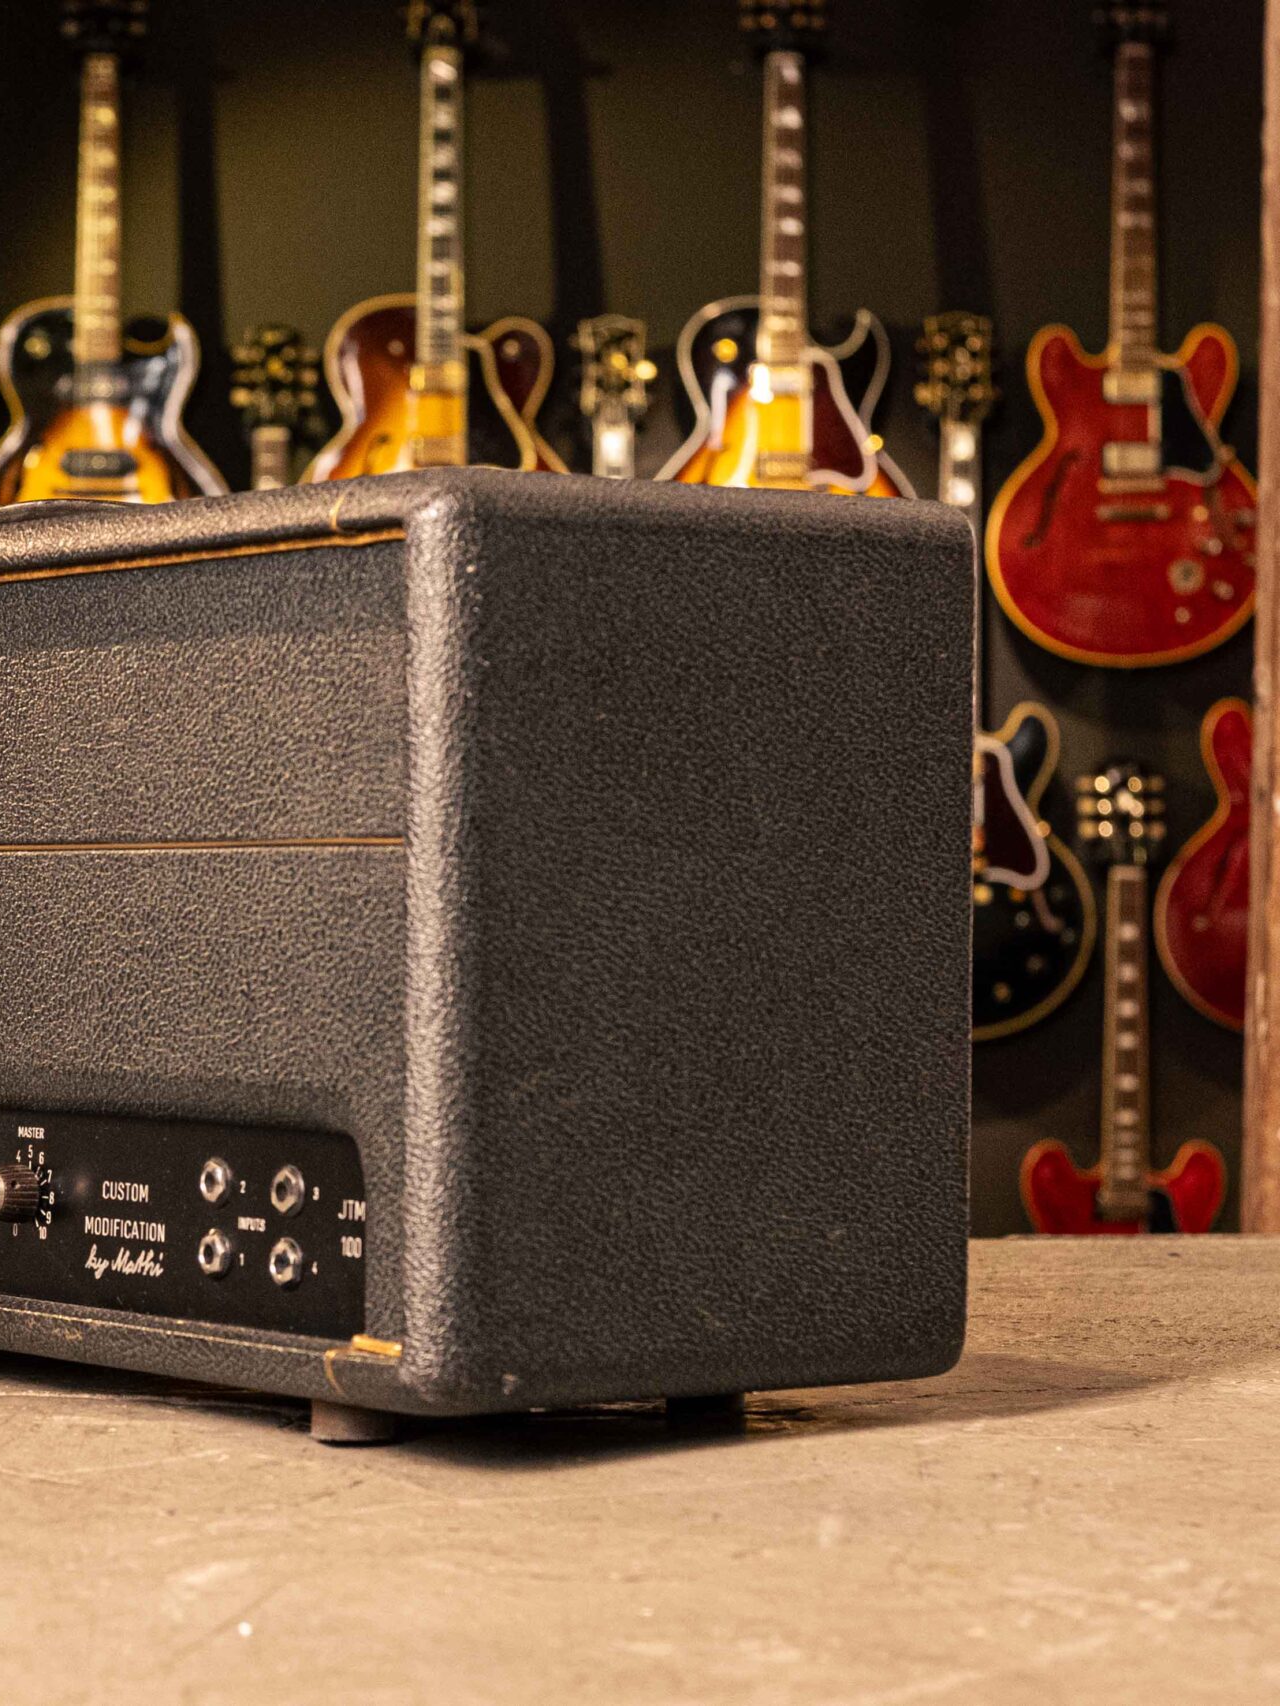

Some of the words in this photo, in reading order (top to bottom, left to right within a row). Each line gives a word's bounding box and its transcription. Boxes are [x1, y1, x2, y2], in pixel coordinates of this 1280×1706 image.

[18, 1126, 44, 1139] MASTER
[16, 1150, 21, 1162] 4
[28, 1144, 33, 1158] 5
[39, 1151, 44, 1165] 6
[47, 1170, 52, 1183] 7
[102, 1180, 149, 1203] CUSTOM
[240, 1180, 246, 1194] 2
[312, 1186, 319, 1200] 3
[49, 1191, 54, 1204] 8
[46, 1211, 51, 1224] 9
[338, 1200, 366, 1222] JTM
[13, 1223, 18, 1236] 0
[84, 1216, 166, 1243] MODIFICATION
[238, 1216, 266, 1232] INPUTS
[39, 1226, 47, 1240] 10
[341, 1236, 362, 1259] 100
[84, 1243, 109, 1280] by
[239, 1253, 244, 1266] 1
[312, 1261, 318, 1275] 4
